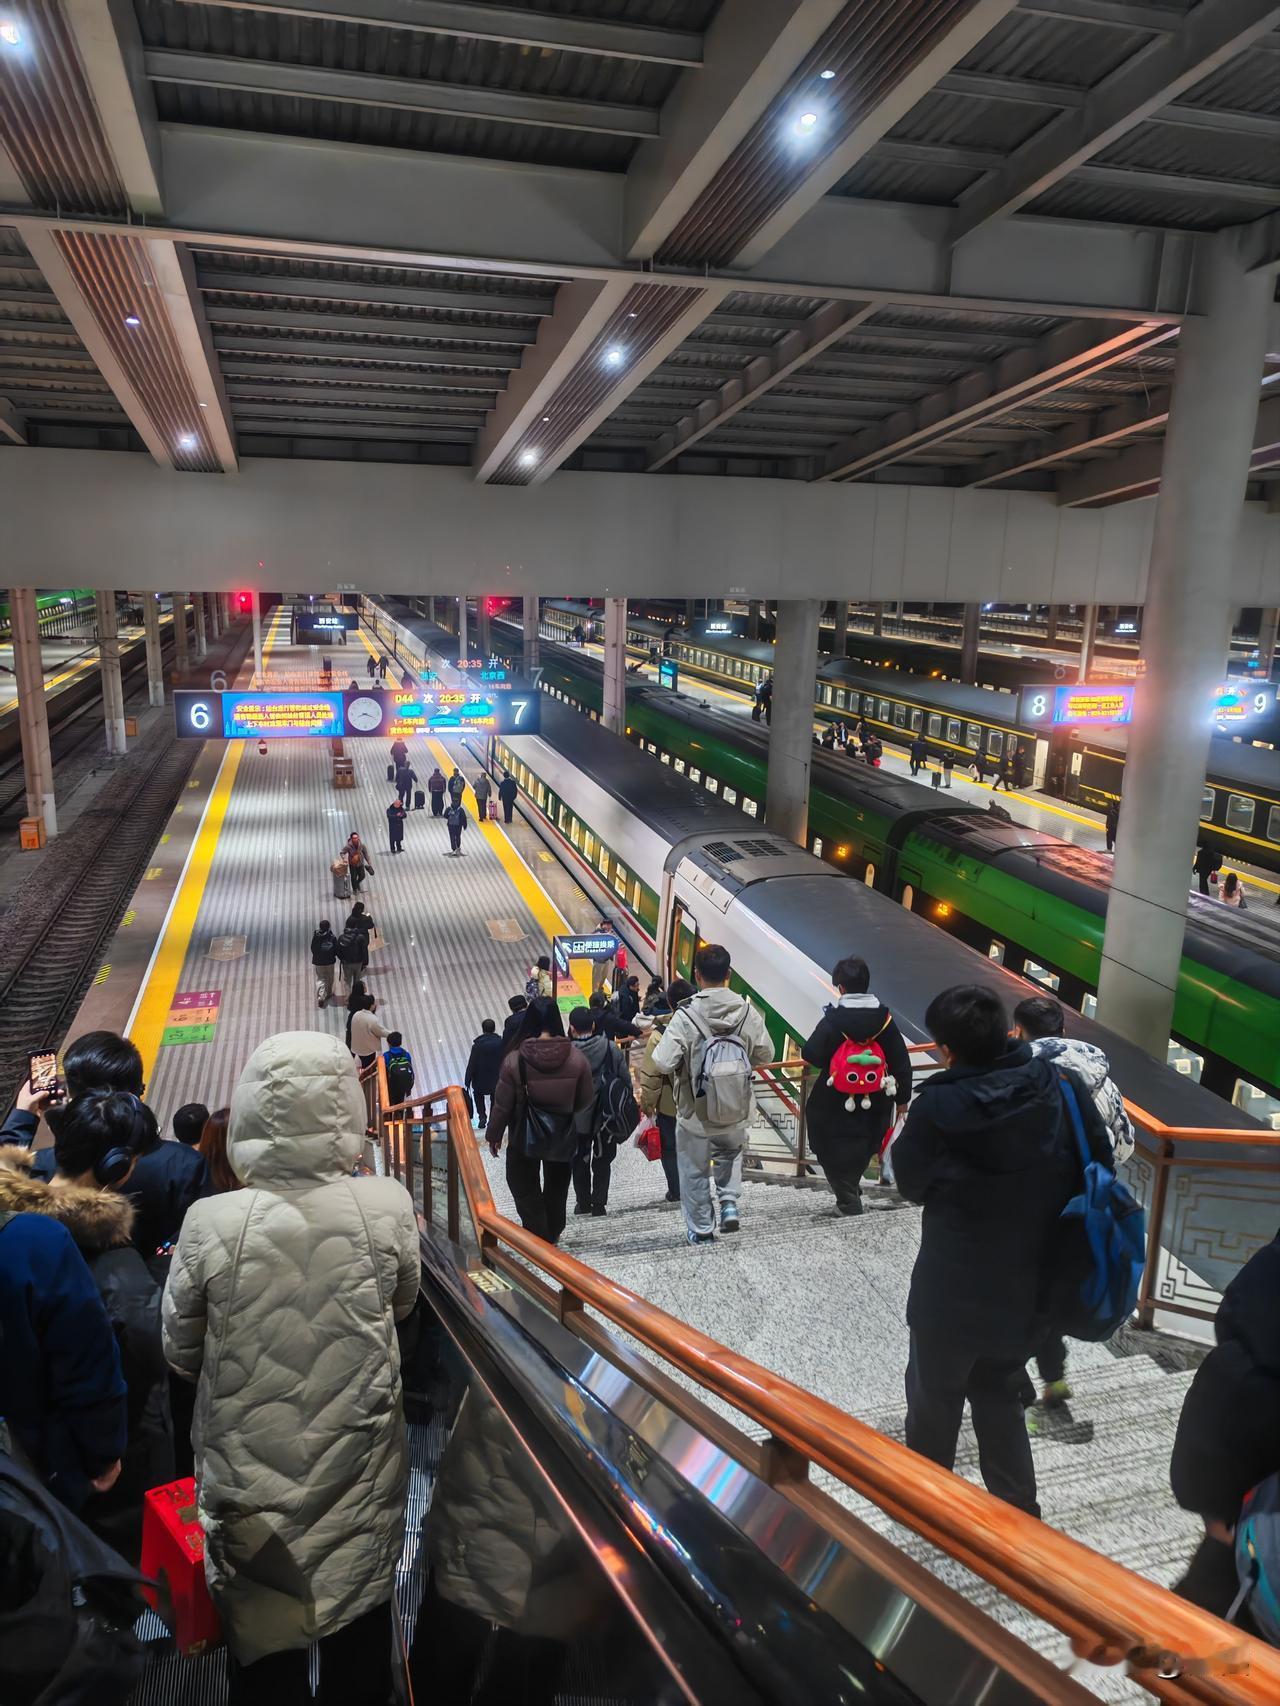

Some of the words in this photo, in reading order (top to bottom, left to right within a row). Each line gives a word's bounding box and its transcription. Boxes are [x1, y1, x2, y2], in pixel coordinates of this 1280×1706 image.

[457, 660, 482, 668] 20:35
[480, 671, 505, 680] 北京西
[395, 694, 414, 703] D44
[423, 692, 434, 704] 次
[439, 694, 466, 703] 20:35
[470, 693, 481, 704] 开
[1031, 695, 1046, 716] 8
[1254, 693, 1267, 713] 9
[190, 703, 209, 729] 6
[511, 702, 528, 725] 7
